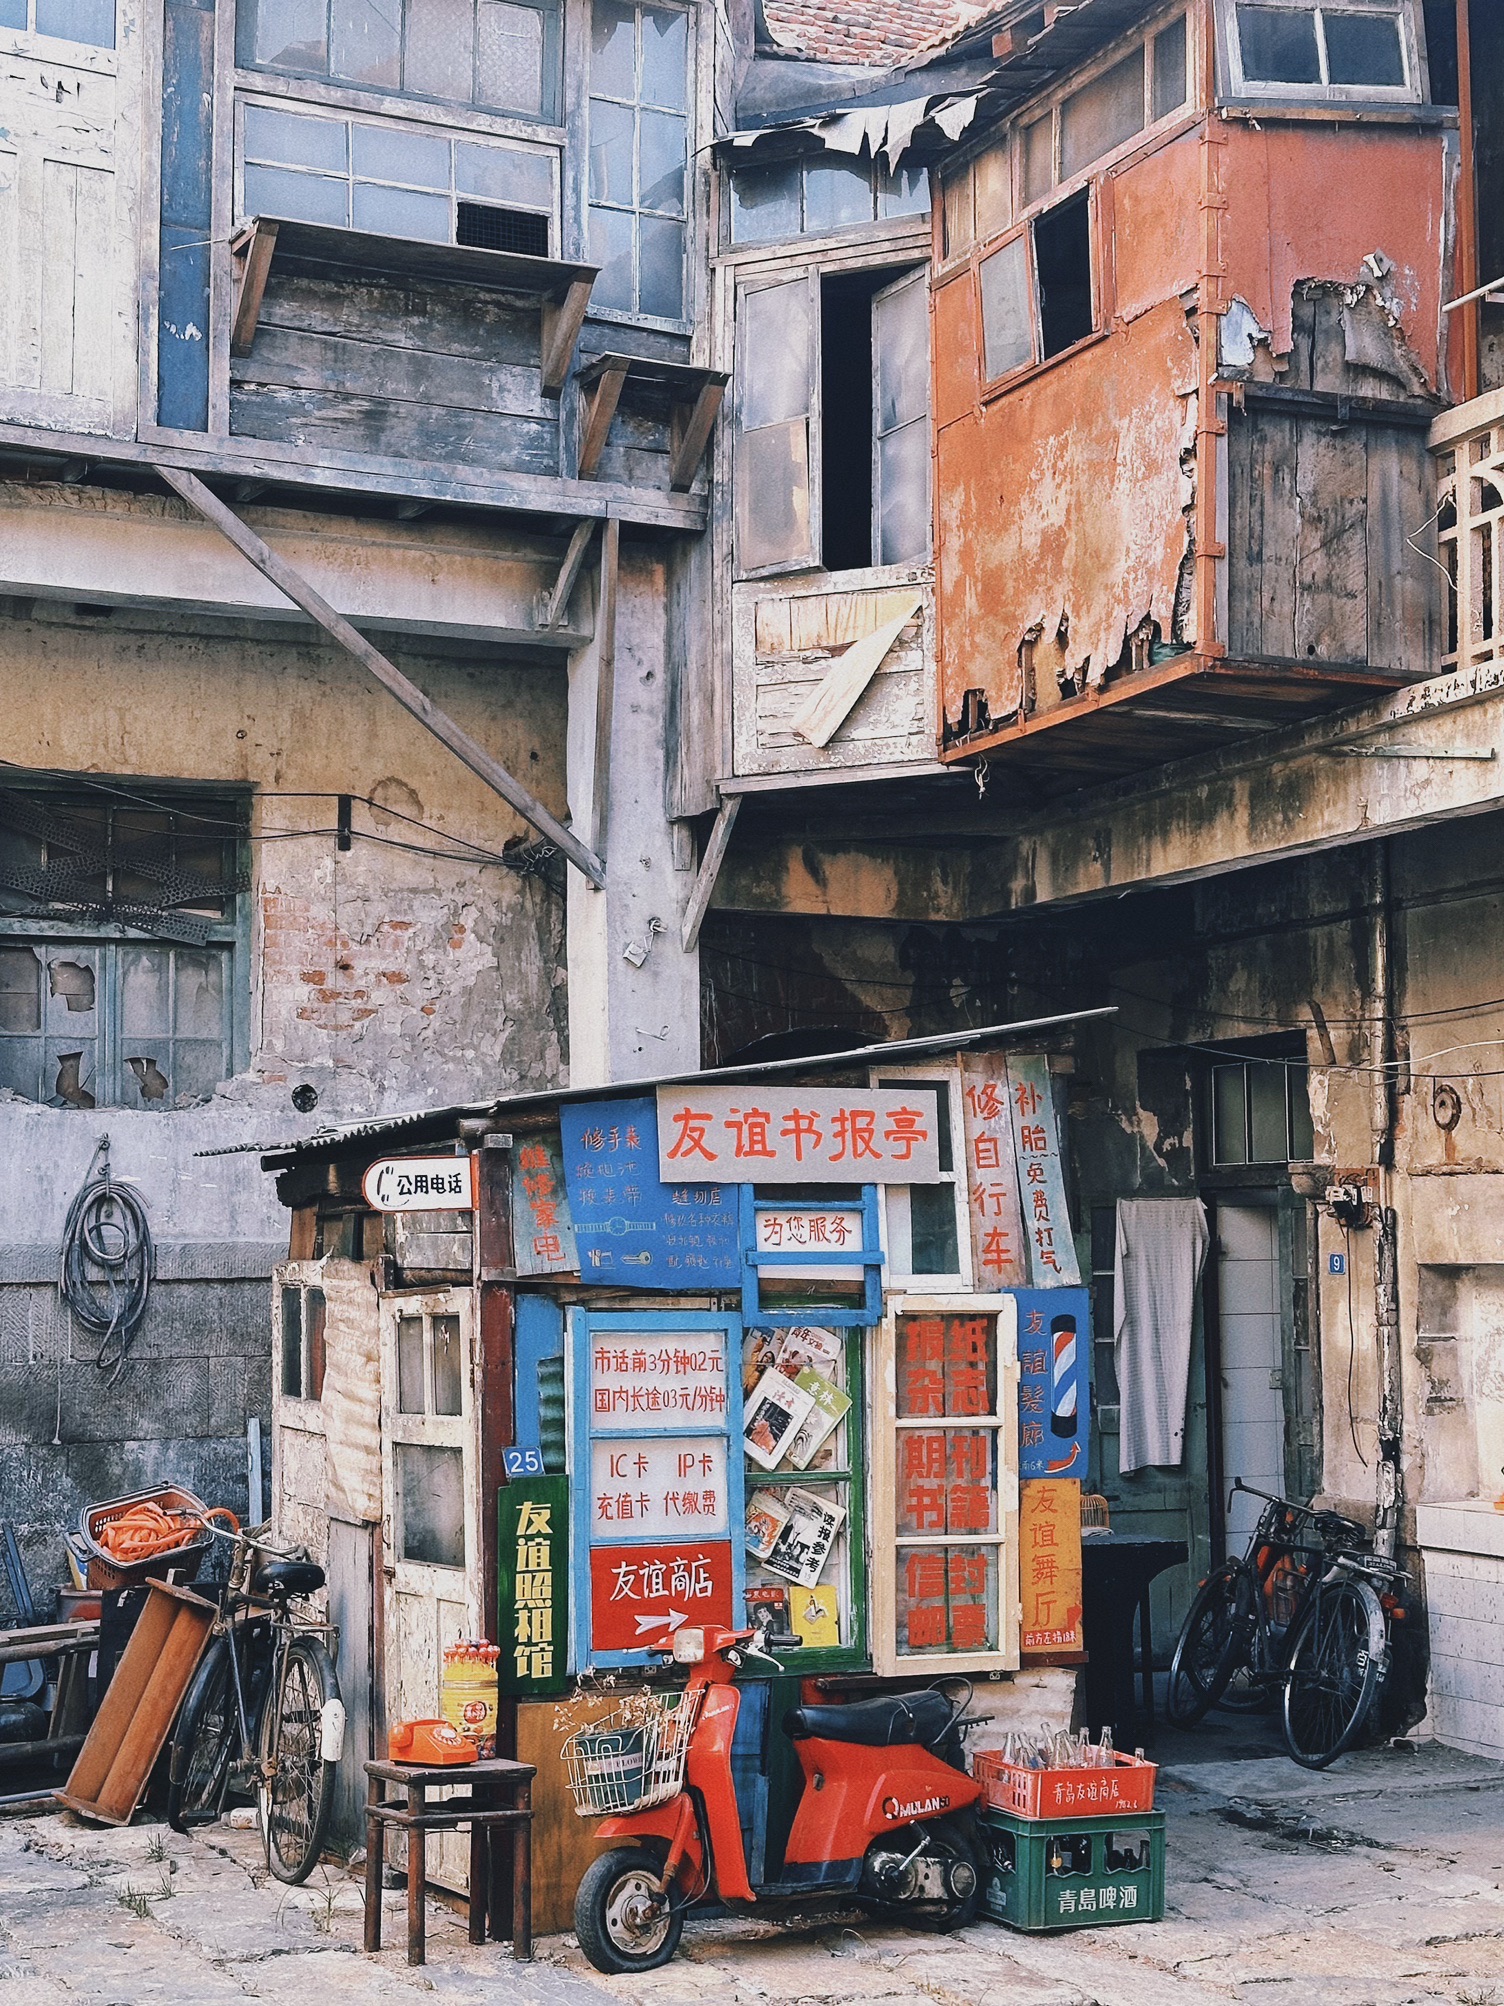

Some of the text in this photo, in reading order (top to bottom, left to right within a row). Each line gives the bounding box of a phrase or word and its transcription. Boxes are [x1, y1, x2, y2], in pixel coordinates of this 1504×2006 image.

[667, 1106, 928, 1162] 友谊书报亭
[1015, 1082, 1047, 1152] 补胎
[397, 1173, 462, 1195] 公用电话
[965, 1082, 1014, 1275] 修自行车
[764, 1216, 852, 1246] 为您服务
[1027, 1162, 1062, 1275] 免费打气
[1333, 1256, 1341, 1271] 9
[509, 1451, 539, 1473] 25
[905, 1435, 986, 1479] 期刊
[597, 1490, 716, 1520] 充值卡 代缴费
[906, 1484, 990, 1529] 书籍
[610, 1553, 713, 1602] 友谊商店
[905, 1553, 988, 1598] 信封
[1029, 1486, 1059, 1628] 友谊舞厅
[514, 1501, 554, 1679] 友谊照相馆
[1058, 1885, 1138, 1914] 青島啤酒
